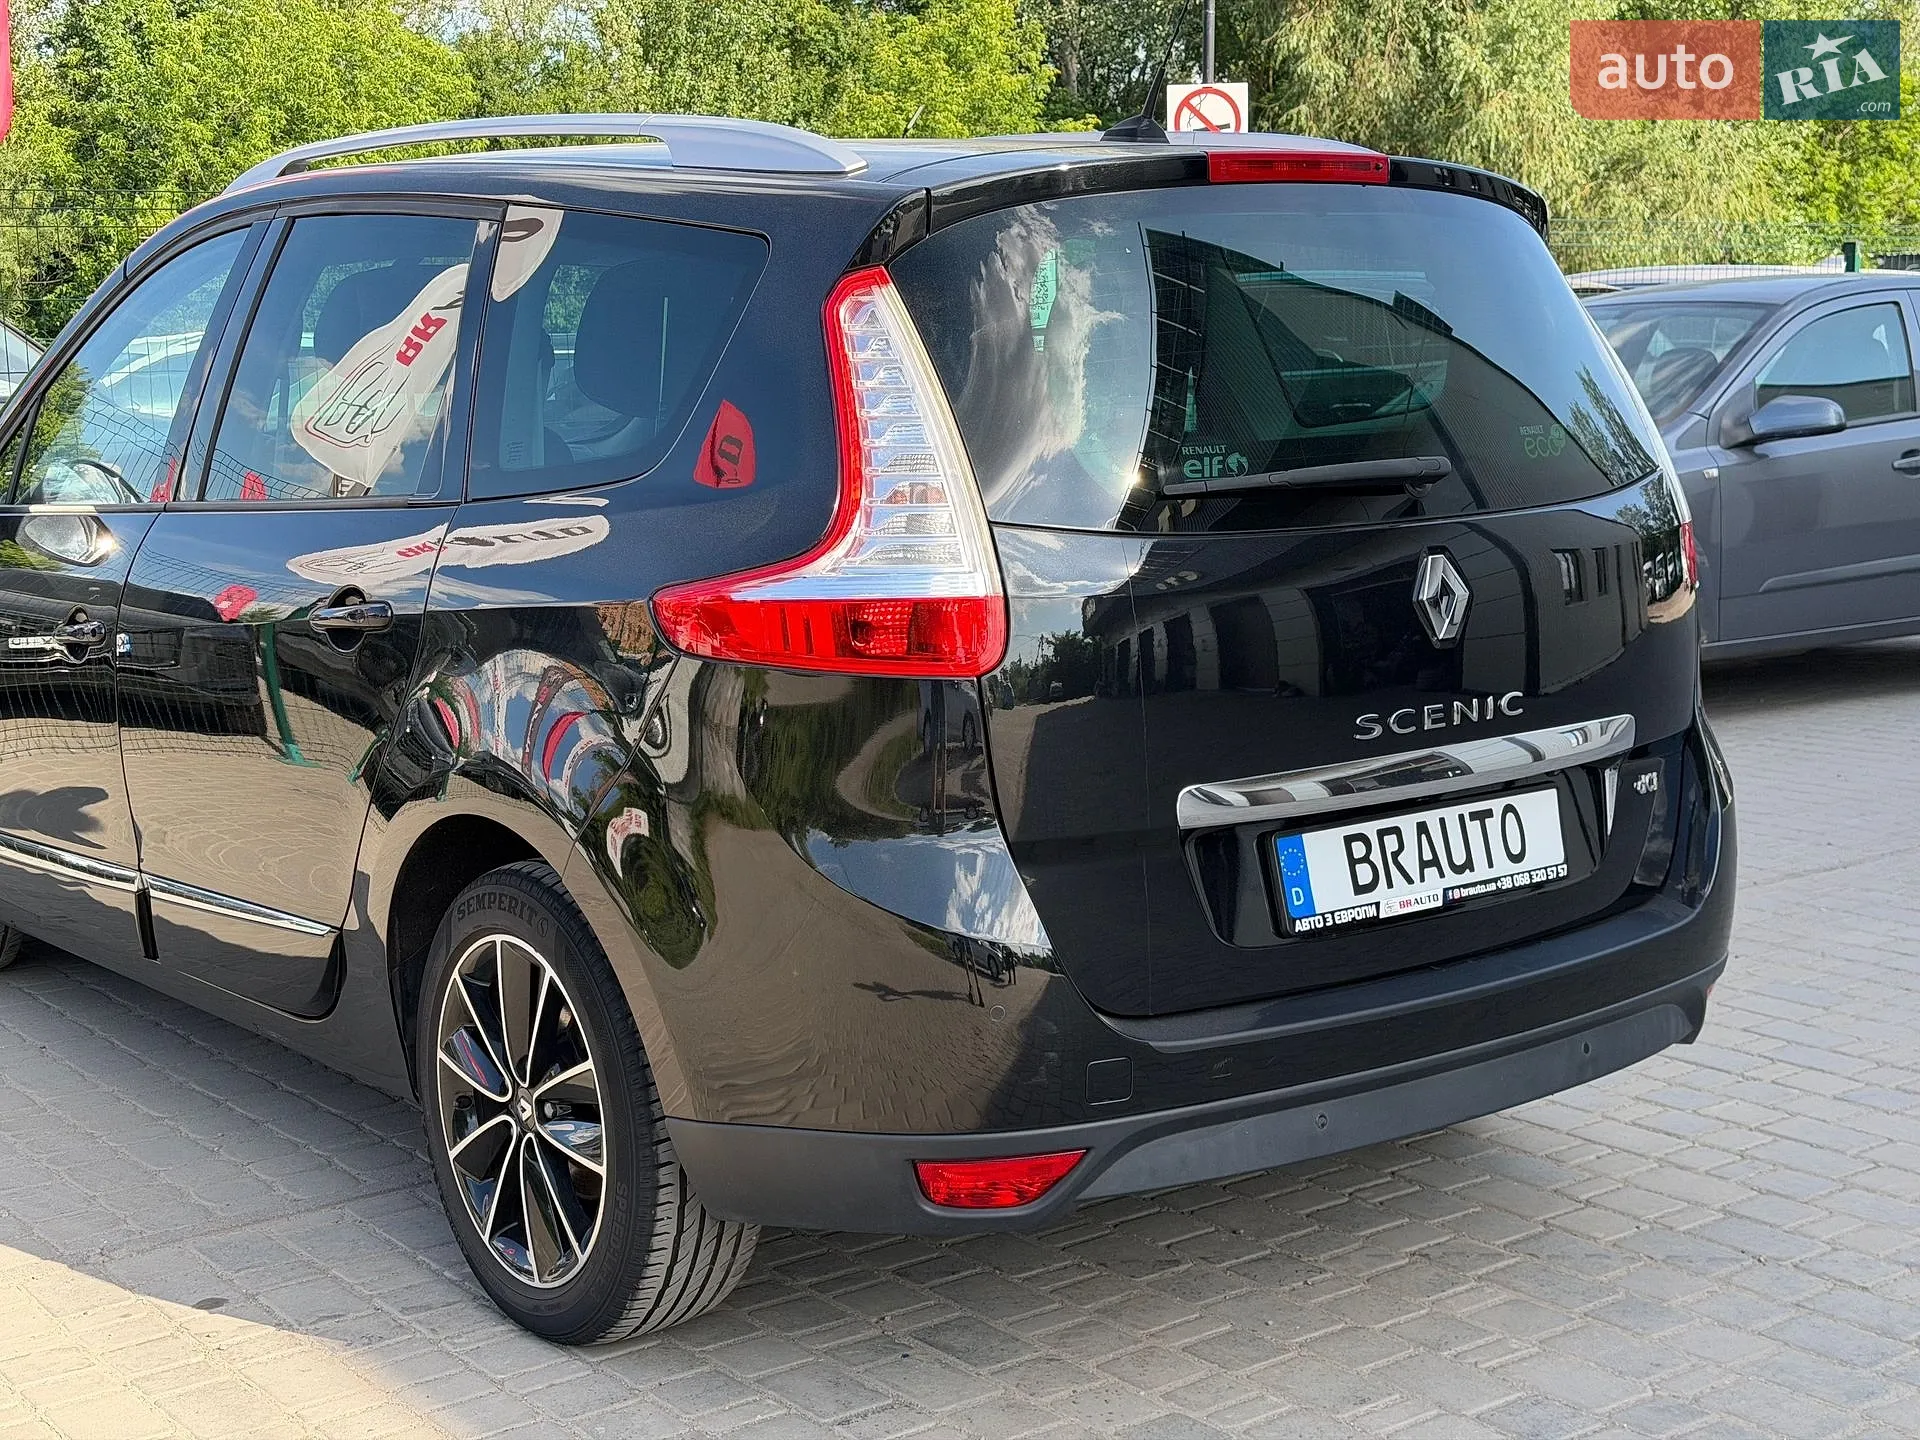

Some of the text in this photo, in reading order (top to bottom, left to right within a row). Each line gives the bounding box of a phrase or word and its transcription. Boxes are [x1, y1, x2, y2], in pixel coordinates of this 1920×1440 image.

[1182, 445, 1227, 455] RENAULT
[1184, 456, 1224, 478] elf
[1353, 691, 1524, 741] SCENIC
[1343, 803, 1527, 896] BRAUTO
[1460, 882, 1497, 897] brauto.ua
[1497, 876, 1513, 890] +38
[1513, 872, 1531, 887] 068
[1530, 868, 1547, 883] 320
[1547, 865, 1557, 880] 57
[1557, 864, 1568, 877] 57
[456, 891, 538, 929] SEMPERIT
[1291, 887, 1304, 906] D
[1399, 893, 1439, 909] BRAUTO
[1295, 916, 1324, 932] АВТО
[1334, 904, 1378, 924] ЄВРОПИ
